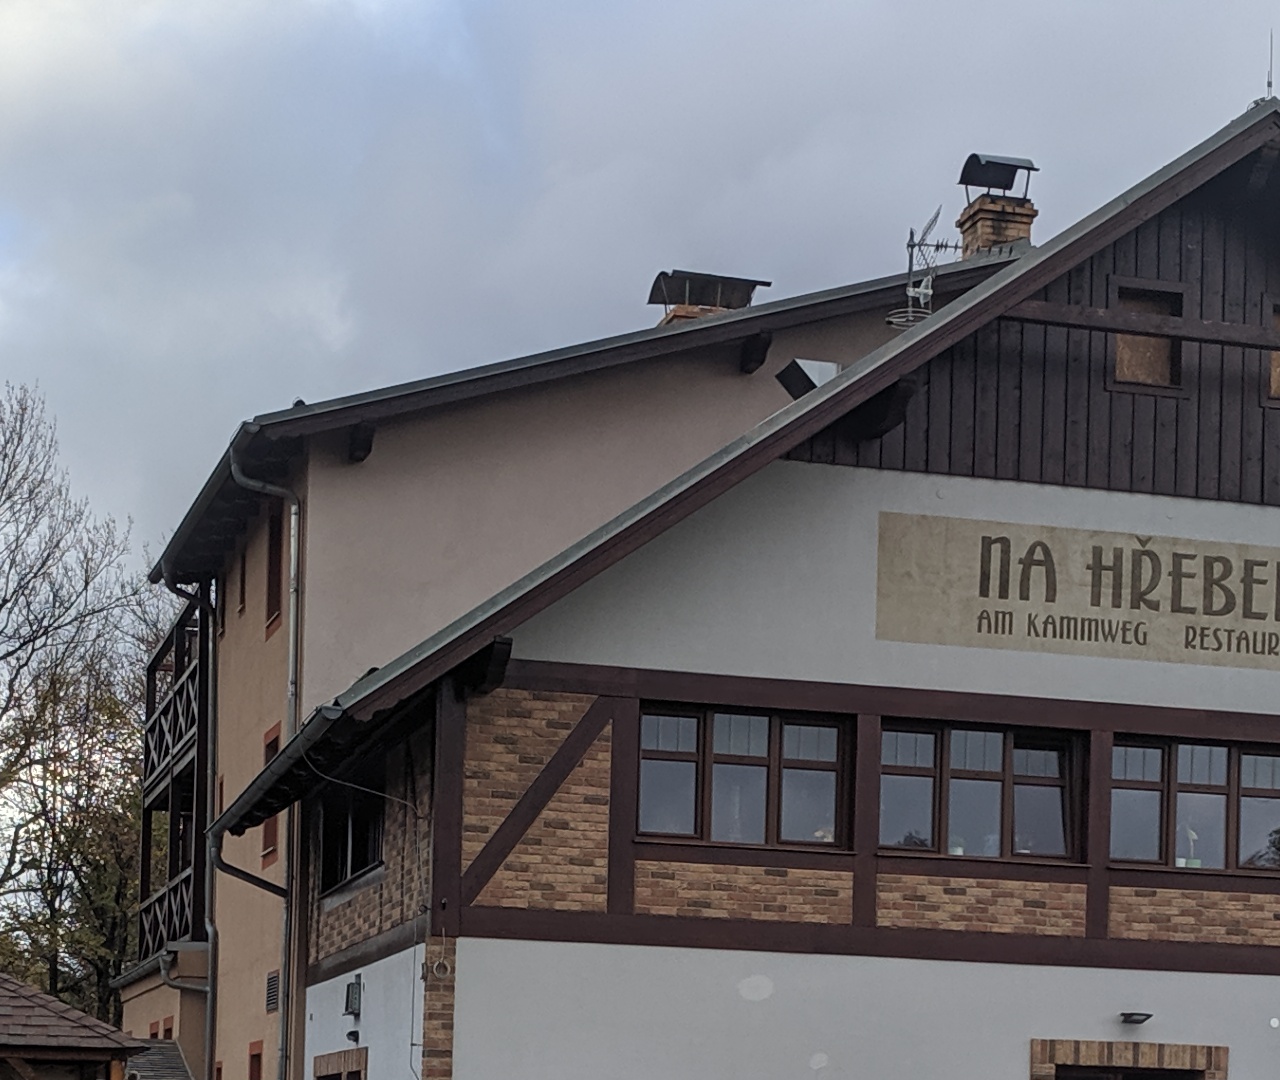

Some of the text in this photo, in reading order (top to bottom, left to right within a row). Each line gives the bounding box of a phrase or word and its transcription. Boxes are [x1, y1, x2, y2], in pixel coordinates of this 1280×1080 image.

[978, 535, 1057, 604] NA
[976, 609, 1014, 636] AM
[1026, 612, 1148, 646] KAMMWEG
